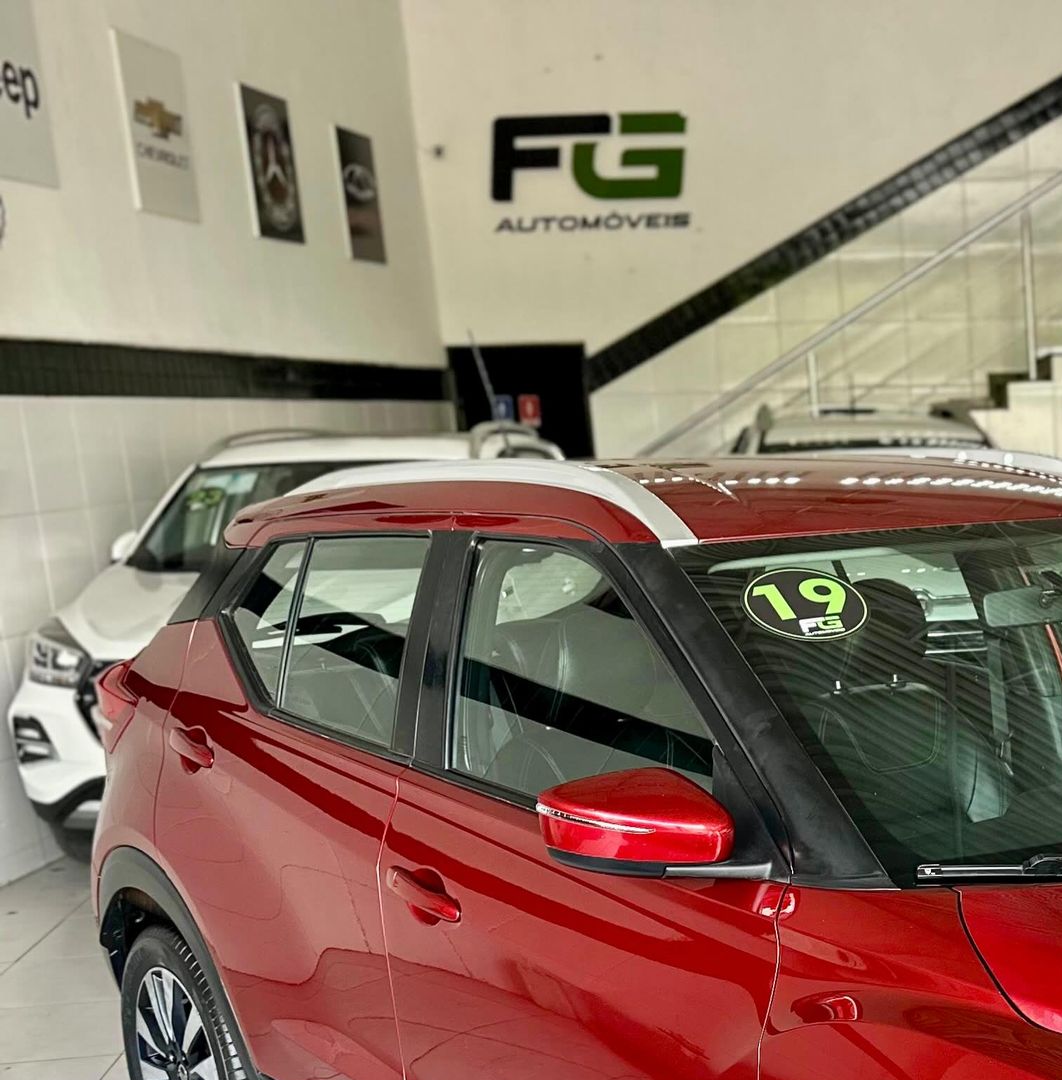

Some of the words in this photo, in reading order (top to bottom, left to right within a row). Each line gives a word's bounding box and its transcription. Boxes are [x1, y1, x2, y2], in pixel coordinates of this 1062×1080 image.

[0, 61, 40, 120] ep
[491, 112, 687, 203] FG
[495, 211, 690, 233] AUTOMÓVEIS
[752, 578, 846, 621] 19
